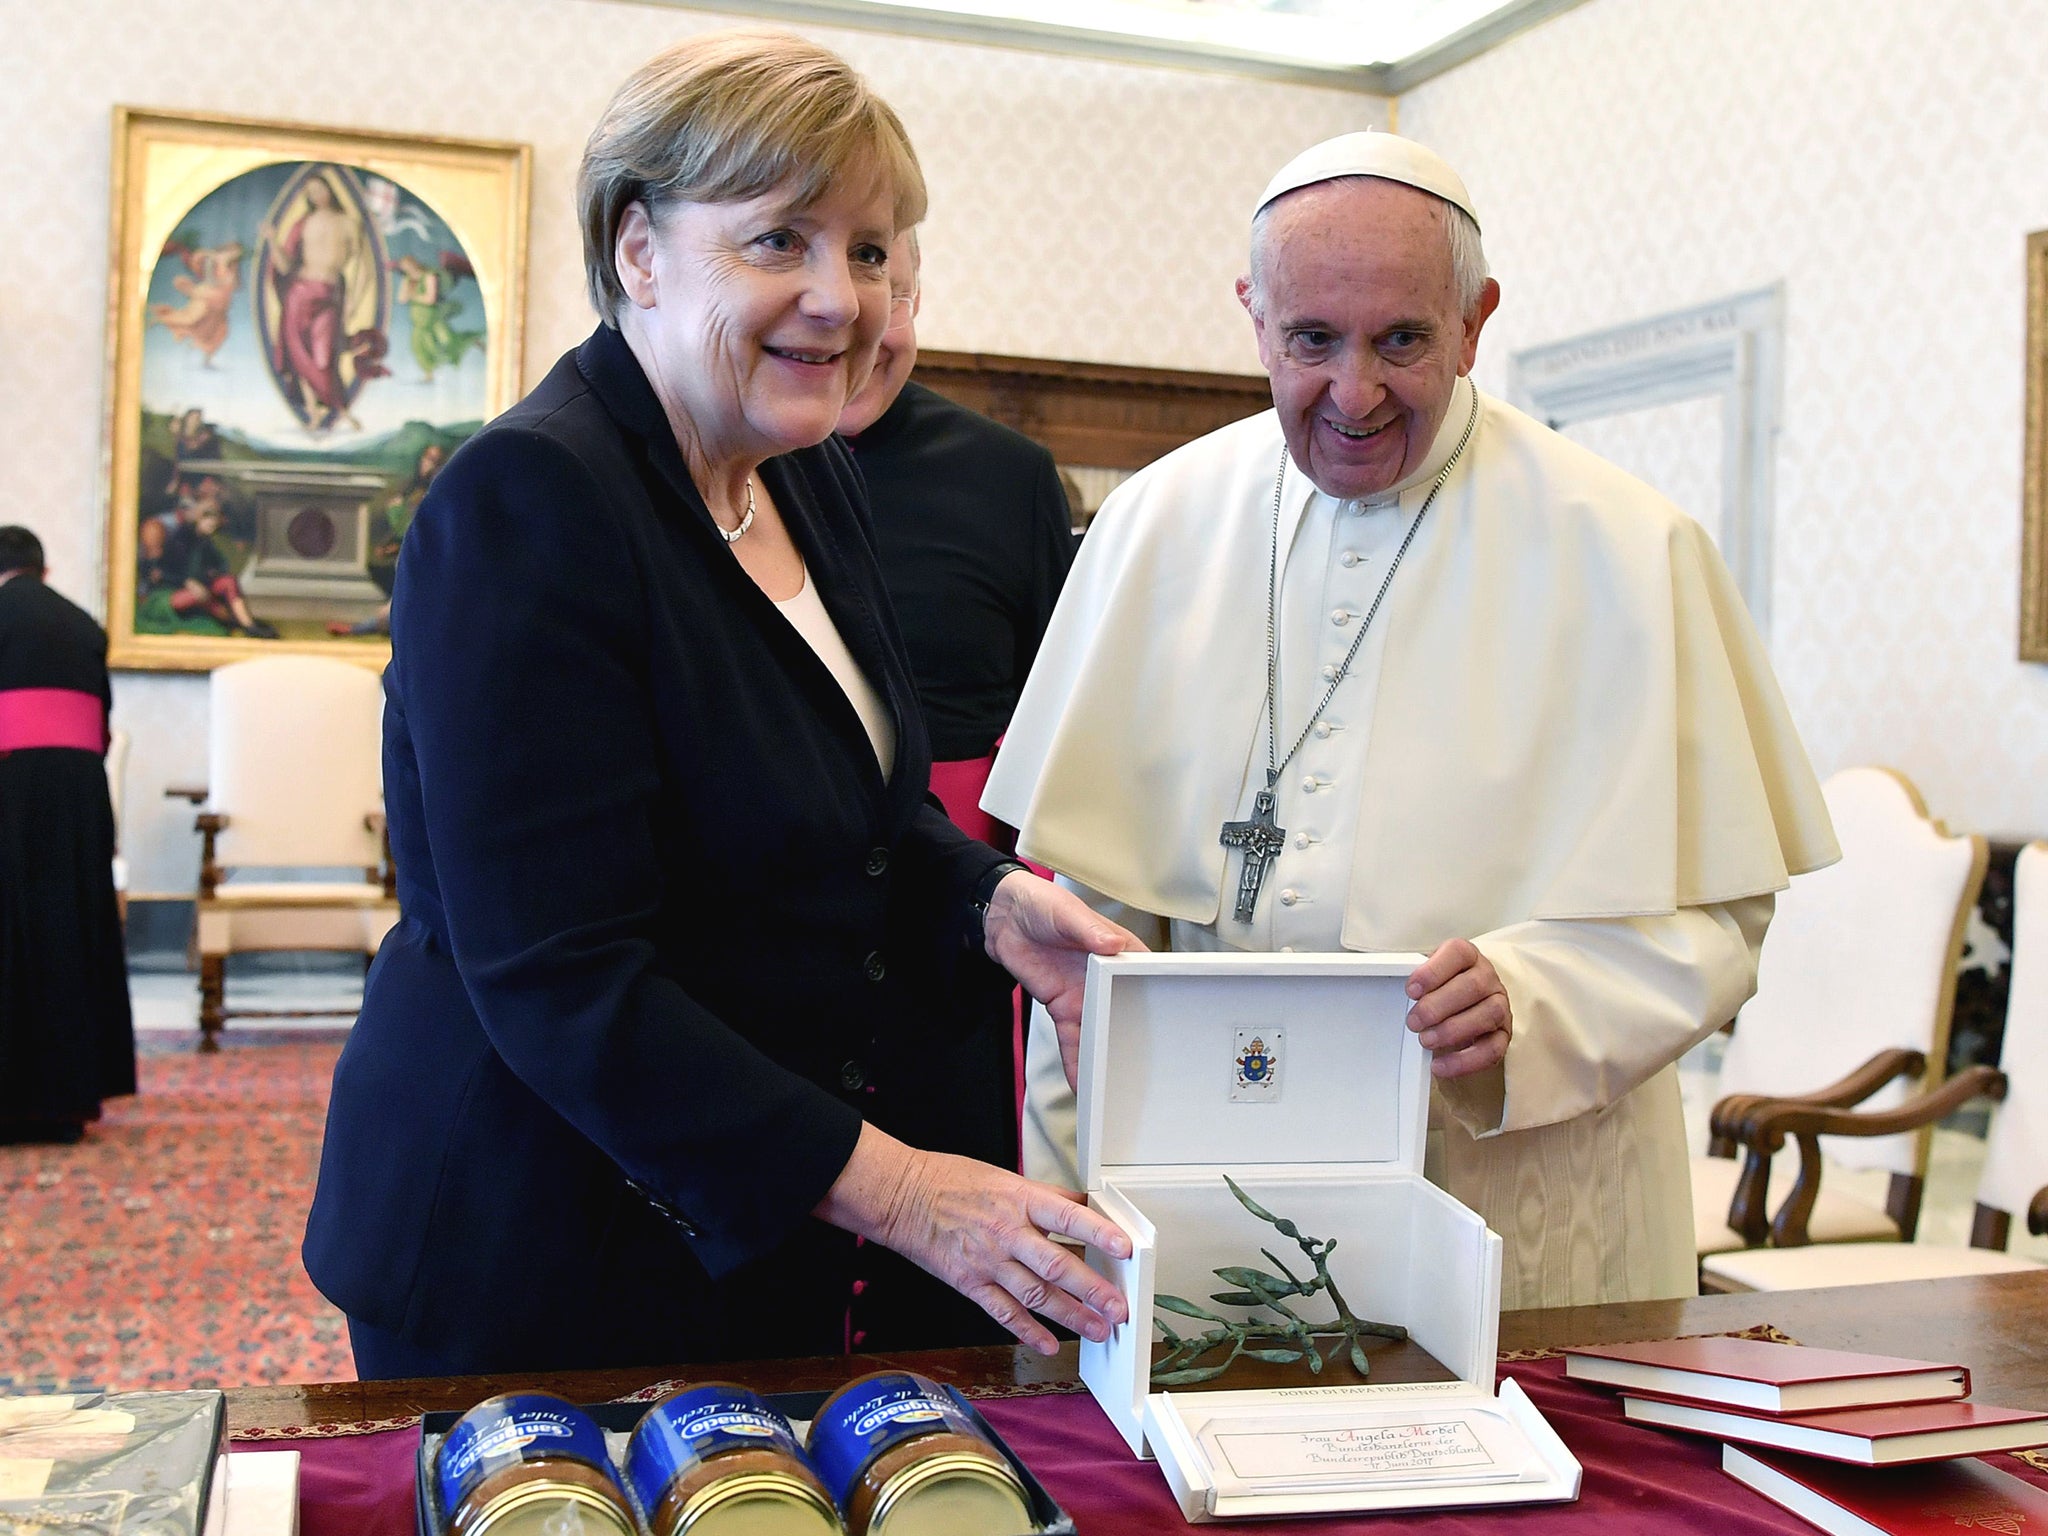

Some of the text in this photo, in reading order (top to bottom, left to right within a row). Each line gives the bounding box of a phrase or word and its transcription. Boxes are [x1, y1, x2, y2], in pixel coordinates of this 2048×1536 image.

[1341, 1387, 1375, 1395] PAPA
[1300, 1433, 1331, 1443] Frau
[1336, 1429, 1395, 1446] Angela
[1435, 1436, 1455, 1446] der
[1407, 1444, 1482, 1459] Deutschland
[1385, 1461, 1409, 1470] Juni
[1411, 1457, 1434, 1466] 2017
